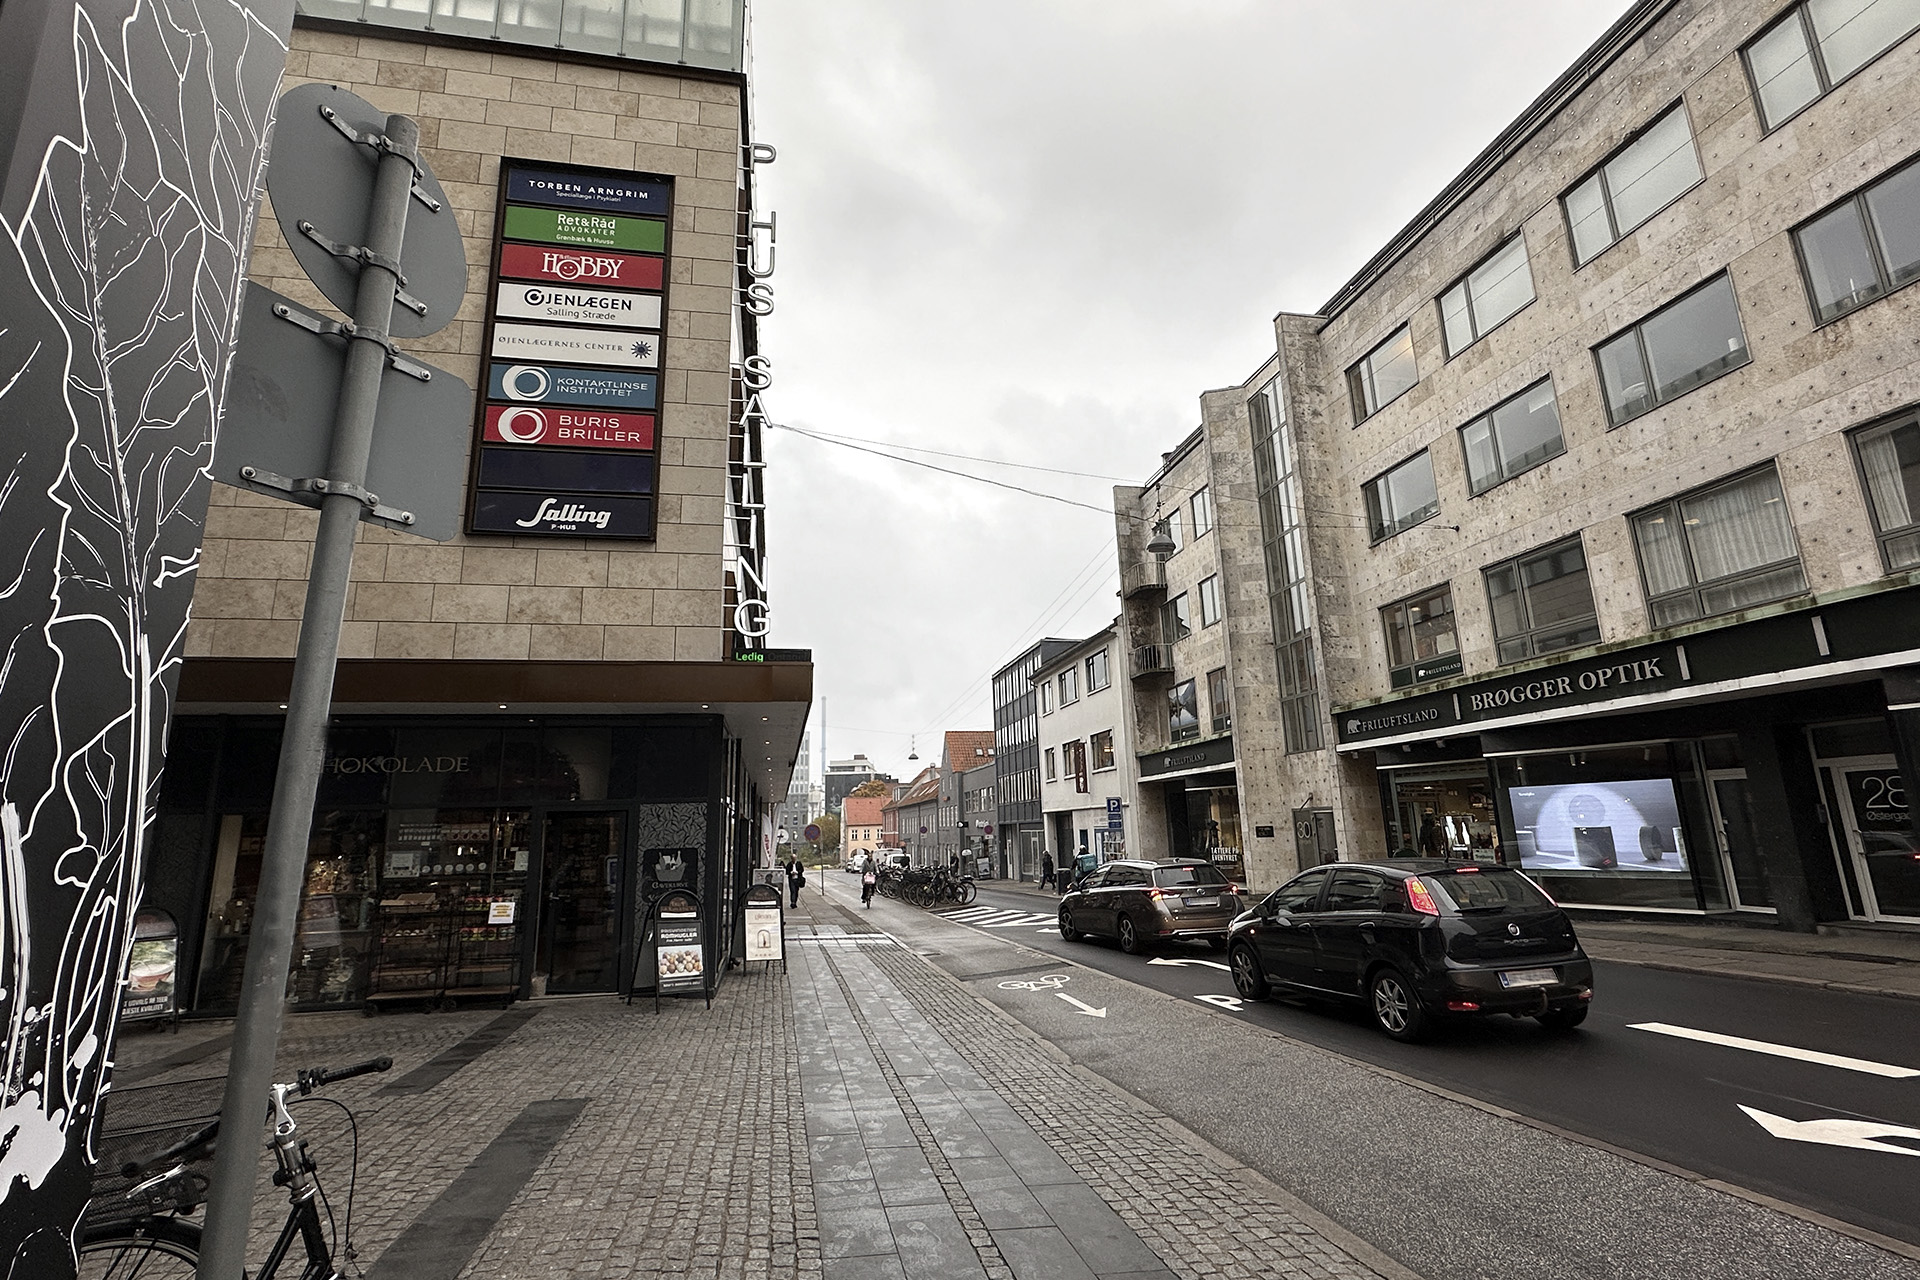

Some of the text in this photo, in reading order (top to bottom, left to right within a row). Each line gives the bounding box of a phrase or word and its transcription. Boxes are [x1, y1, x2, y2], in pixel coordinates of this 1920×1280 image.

[528, 180, 649, 199] TORBEN ARNGRIM
[556, 191, 592, 200] Speciallæge
[557, 214, 616, 229] Ret&Råd
[557, 226, 616, 235] ADVOKATER
[556, 234, 586, 242] Grønbæk
[541, 252, 625, 280] HOBBY
[546, 308, 616, 321] Salling Stræde
[498, 336, 624, 352] ØJENLÆGERNES CENTER
[556, 385, 632, 397] INSTITUTTET
[557, 378, 648, 391] KONTAKTLINSE
[733, 142, 777, 638] P HUS SALLING
[559, 415, 620, 428] BURIS
[558, 428, 641, 443] BRILLER
[515, 498, 612, 529] Salling
[735, 652, 764, 663] Ledig
[1425, 662, 1461, 675] FRILUFTSLAND
[1470, 657, 1665, 712] BRØGGER OPTIK
[1361, 708, 1438, 732] FRILUFTSLAND
[320, 756, 470, 774] HOKOLADE
[1110, 800, 1118, 811] P
